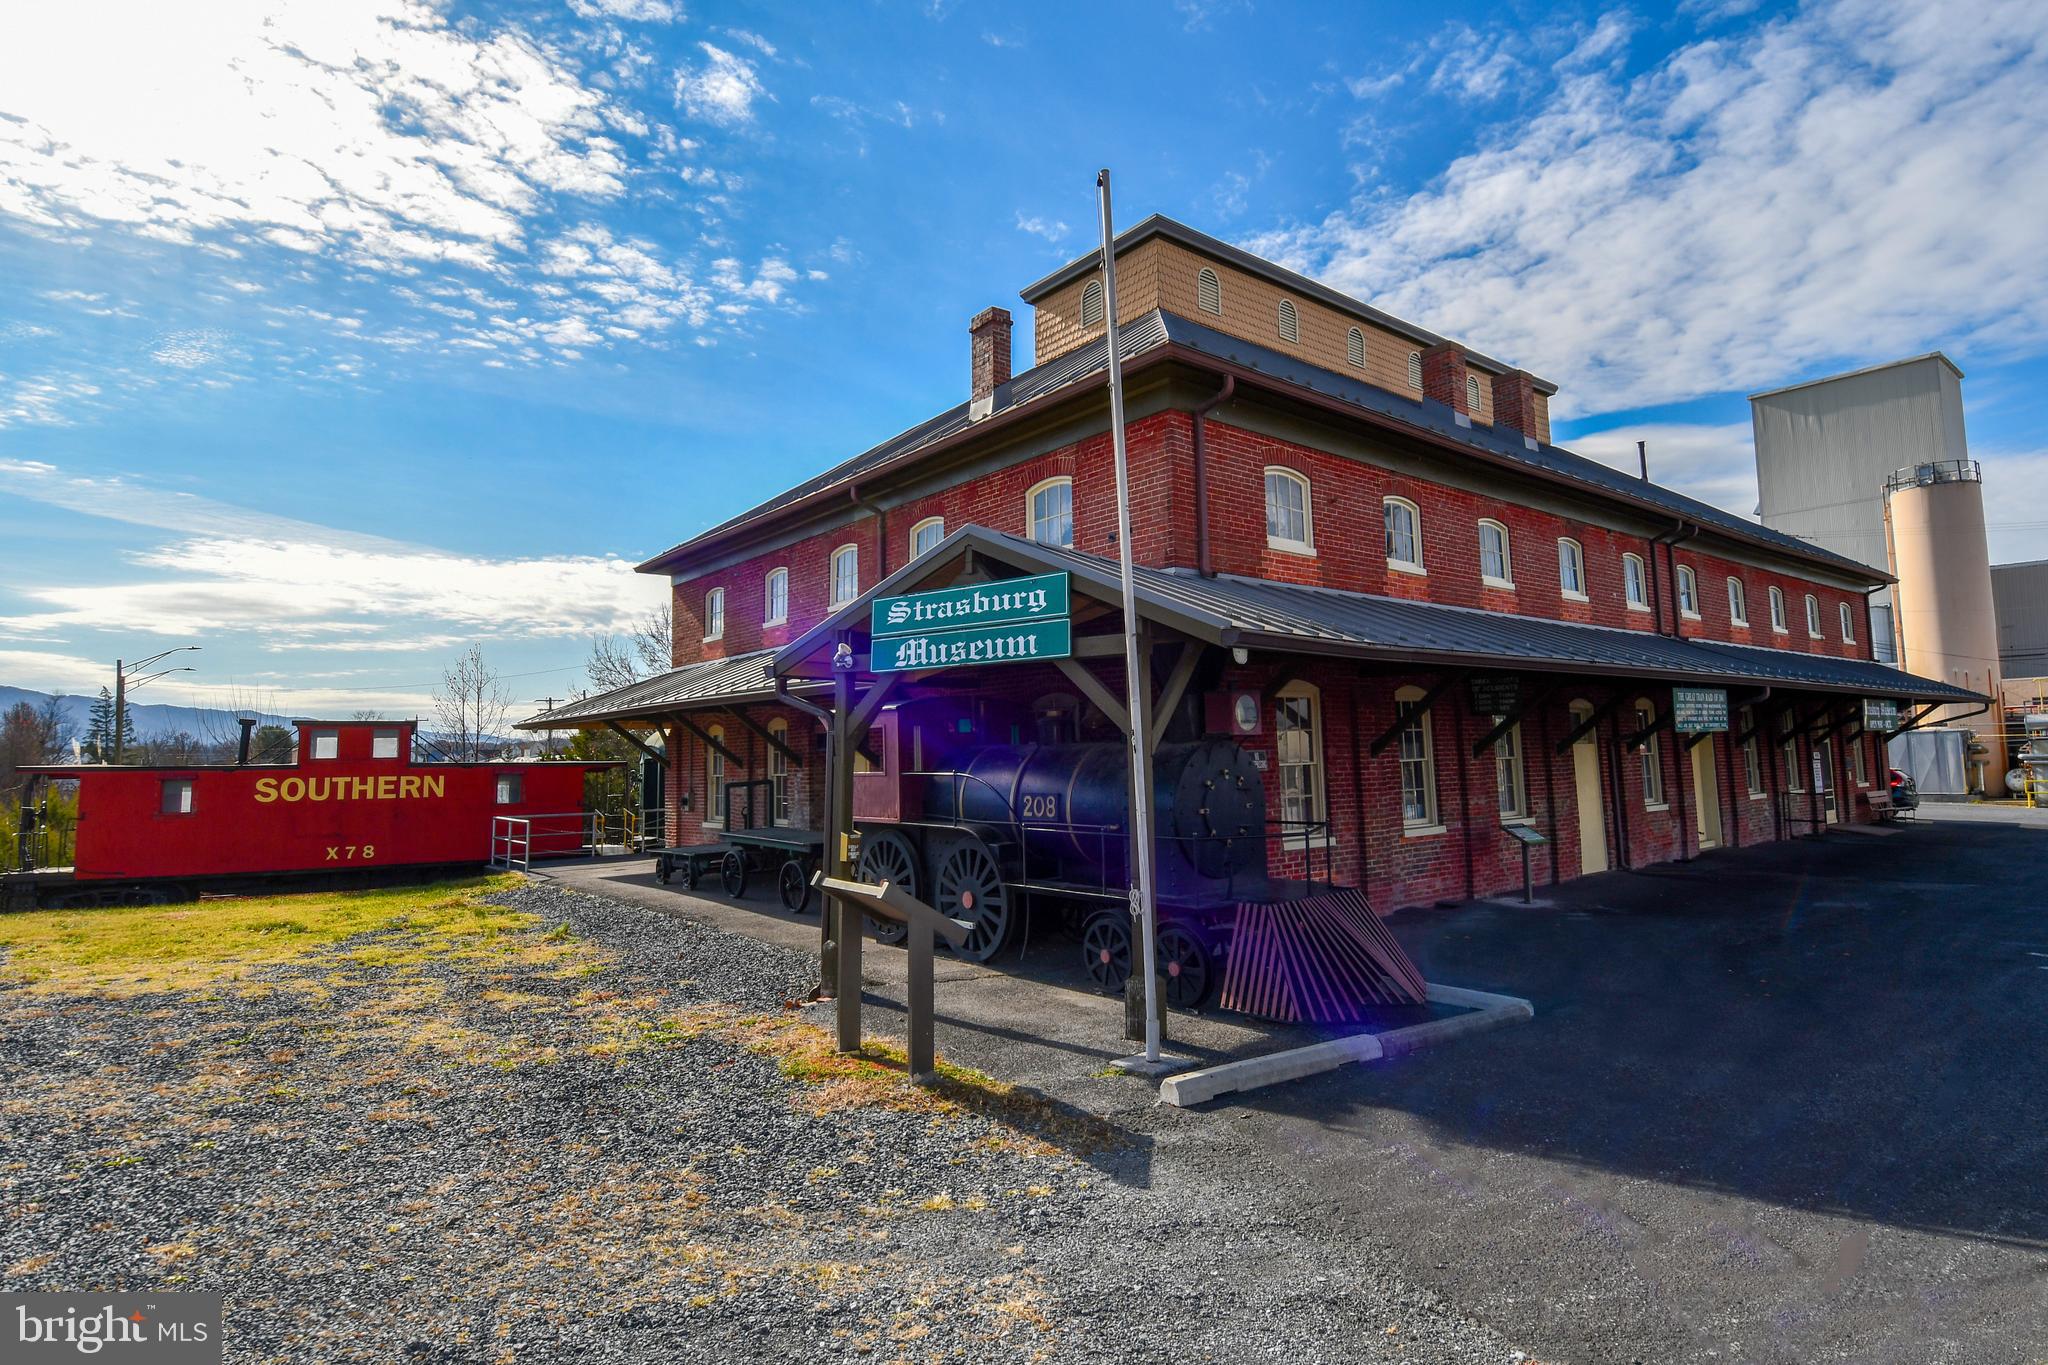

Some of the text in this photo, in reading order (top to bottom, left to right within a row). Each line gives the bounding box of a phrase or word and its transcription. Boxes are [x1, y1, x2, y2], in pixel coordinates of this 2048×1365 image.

[887, 589, 1047, 625] Strasburg
[894, 634, 1038, 668] Museum
[254, 775, 445, 803] SOUTHERN
[1023, 795, 1056, 817] 208
